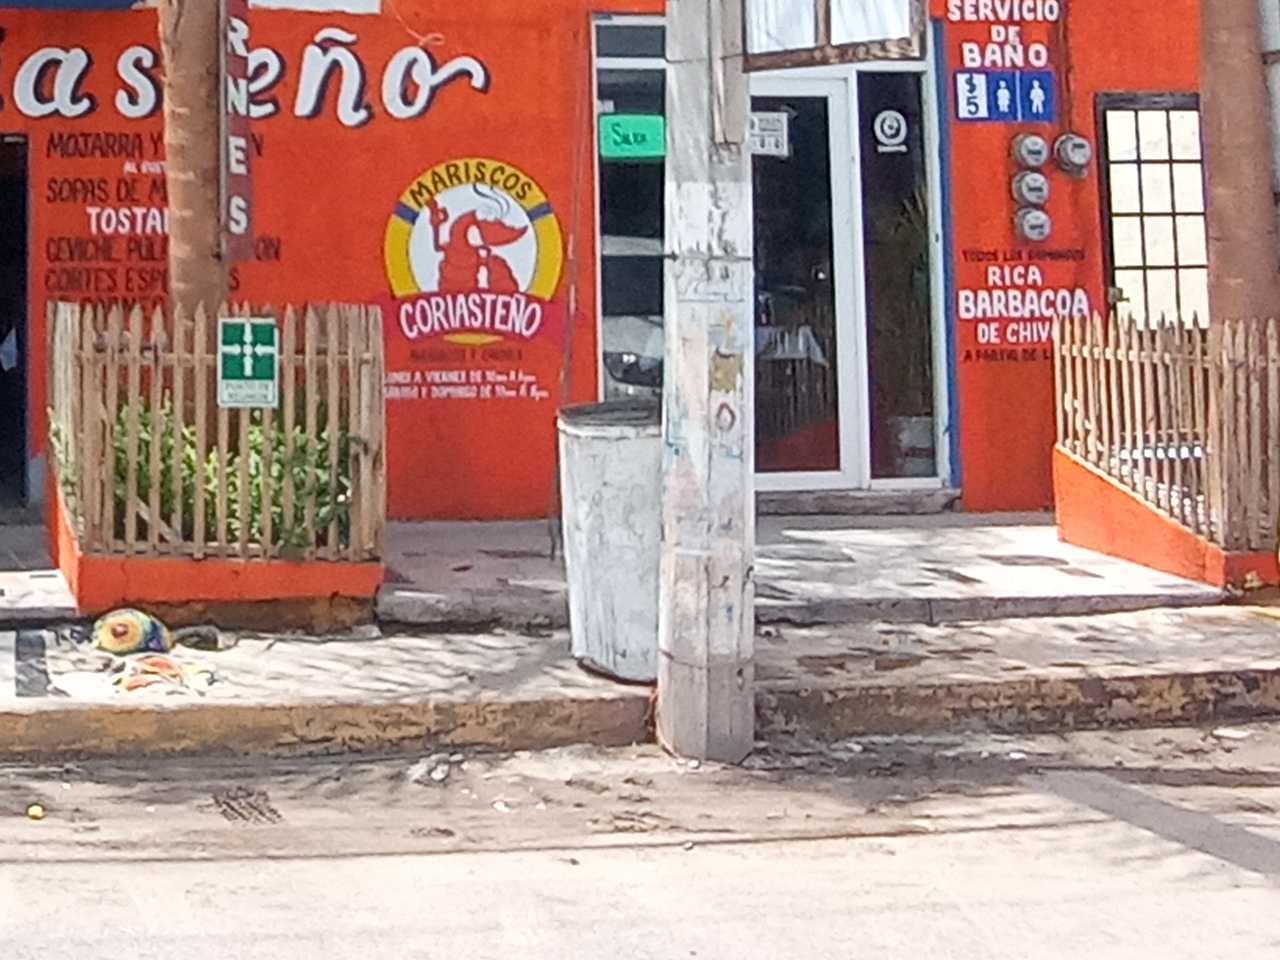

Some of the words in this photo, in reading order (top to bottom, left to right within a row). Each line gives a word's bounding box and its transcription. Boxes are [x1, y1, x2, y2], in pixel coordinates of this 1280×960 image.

[990, 25, 1020, 42] DE
[966, 96, 979, 115] 5
[46, 132, 142, 159] MOJARRA
[46, 177, 108, 203] SOPAS
[117, 178, 140, 203] DE
[410, 161, 533, 209] MARISCOS
[86, 206, 168, 235] TOSTA
[987, 265, 1043, 286] RICA
[957, 287, 1090, 319] BARBACOA
[400, 293, 542, 340] CORIASTEÑO
[977, 322, 1000, 343] DE
[1006, 321, 1051, 343] CHIV
